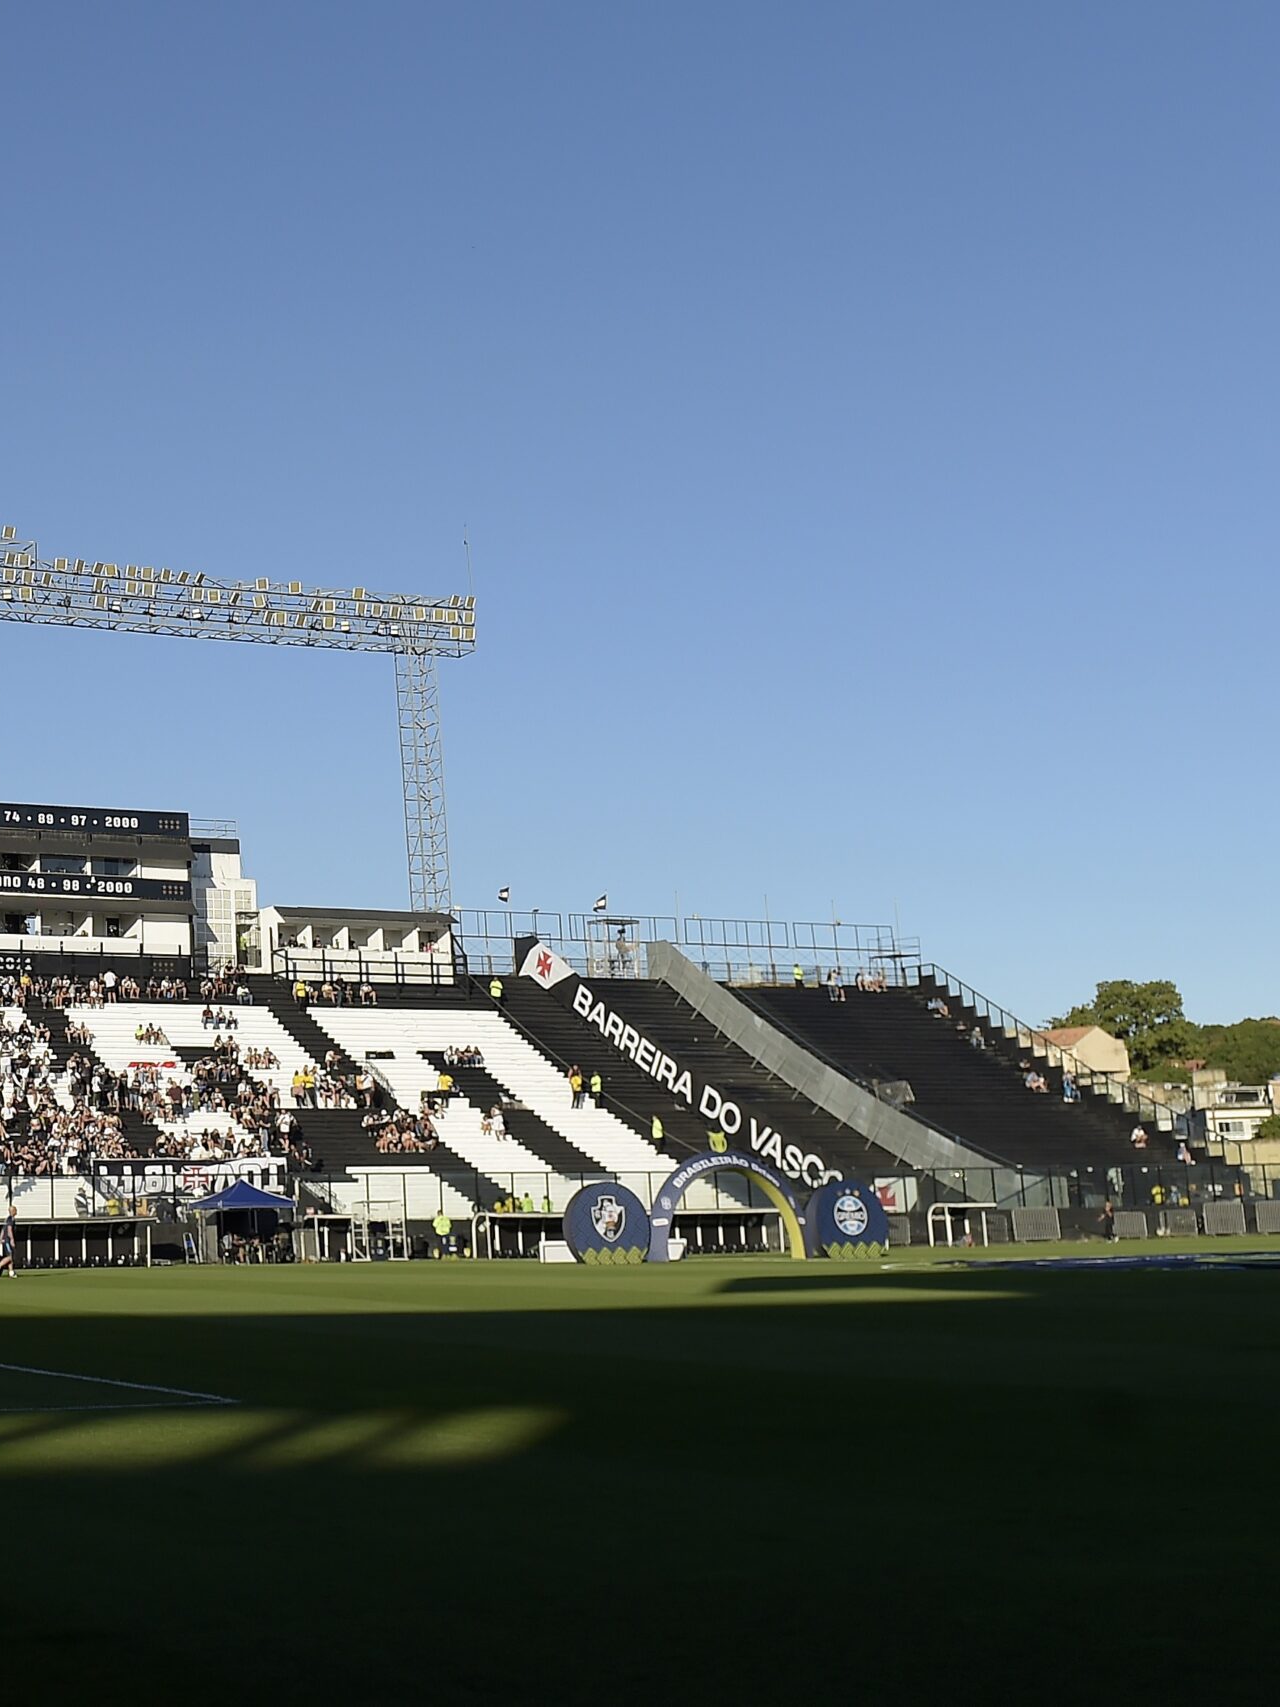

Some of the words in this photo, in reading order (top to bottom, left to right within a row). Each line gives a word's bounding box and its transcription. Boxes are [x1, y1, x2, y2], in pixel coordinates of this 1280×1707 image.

[4, 810, 20, 822] 74
[37, 813, 54, 824] 89
[71, 814, 87, 826] 97
[105, 816, 139, 828] 2000
[27, 877, 45, 889] 48
[63, 879, 80, 891] 98
[97, 881, 133, 893] 2000
[572, 983, 693, 1105] BARREIRA
[698, 1084, 742, 1135] DO
